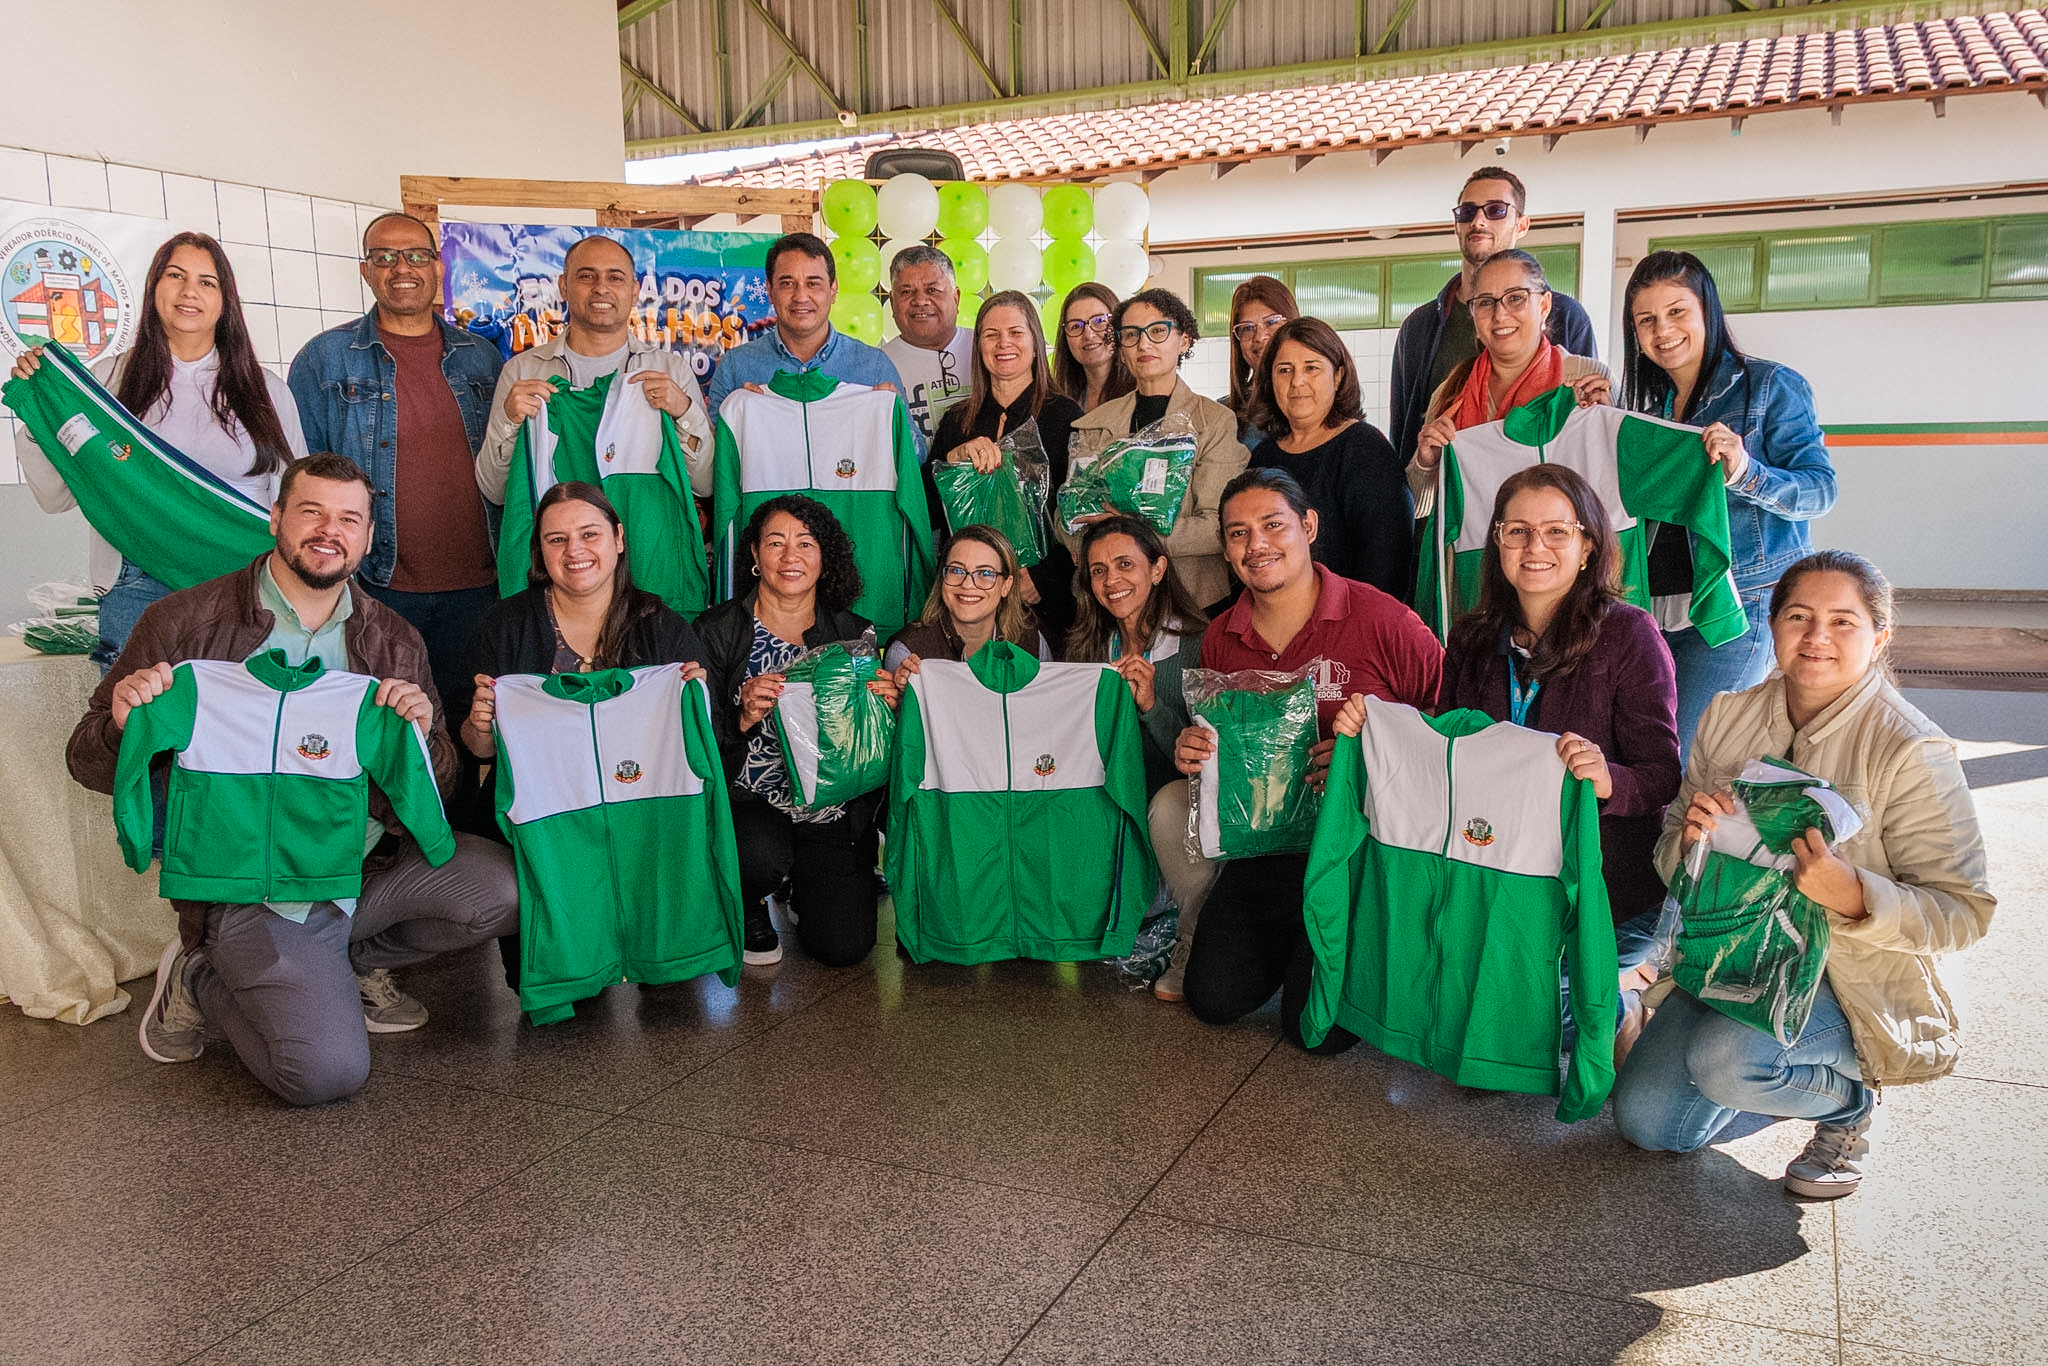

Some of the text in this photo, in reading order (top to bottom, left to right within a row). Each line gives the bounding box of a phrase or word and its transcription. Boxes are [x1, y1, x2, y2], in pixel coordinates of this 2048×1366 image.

[0, 231, 33, 260] VEREADOR
[74, 236, 103, 258] NUNES
[100, 256, 112, 268] DE
[110, 269, 129, 301] MATOS
[666, 276, 721, 307] DOS
[115, 311, 132, 353] RESPEITAR
